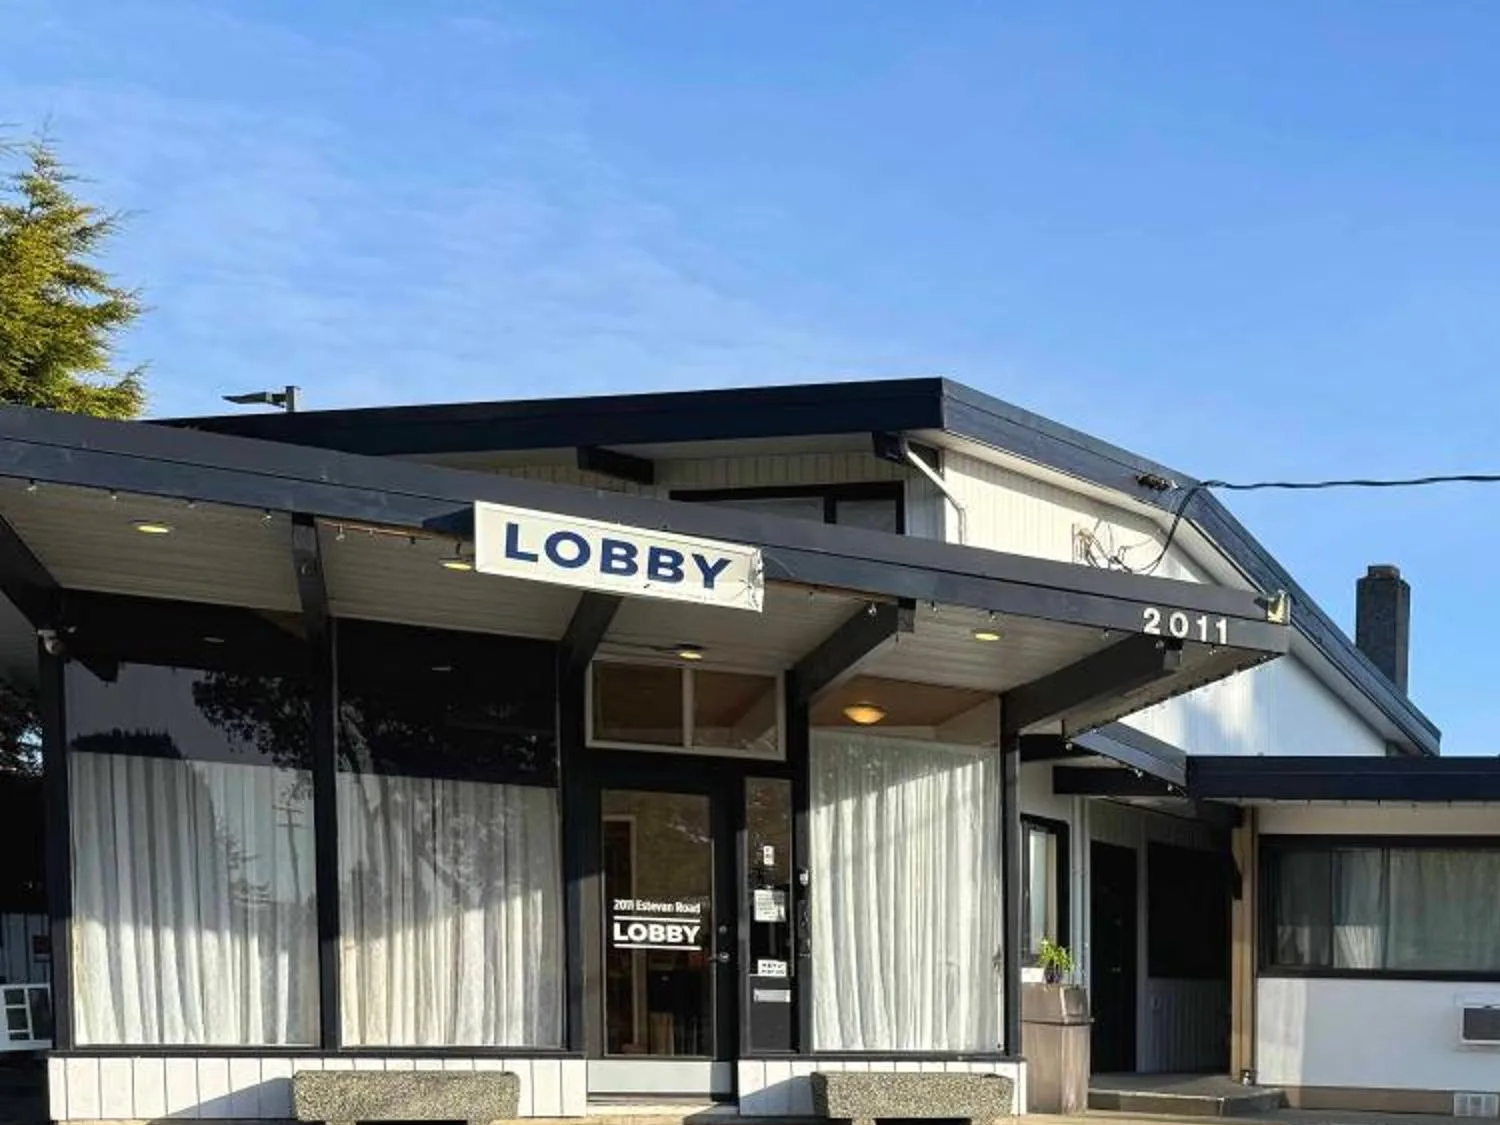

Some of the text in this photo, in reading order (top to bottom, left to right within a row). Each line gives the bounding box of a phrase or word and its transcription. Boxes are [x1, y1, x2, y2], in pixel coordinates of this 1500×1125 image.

[505, 522, 732, 589] LOBBY
[1143, 607, 1227, 645] 2011
[613, 899, 634, 911] 2011
[676, 902, 701, 913] Road
[613, 922, 701, 943] LOBBY
